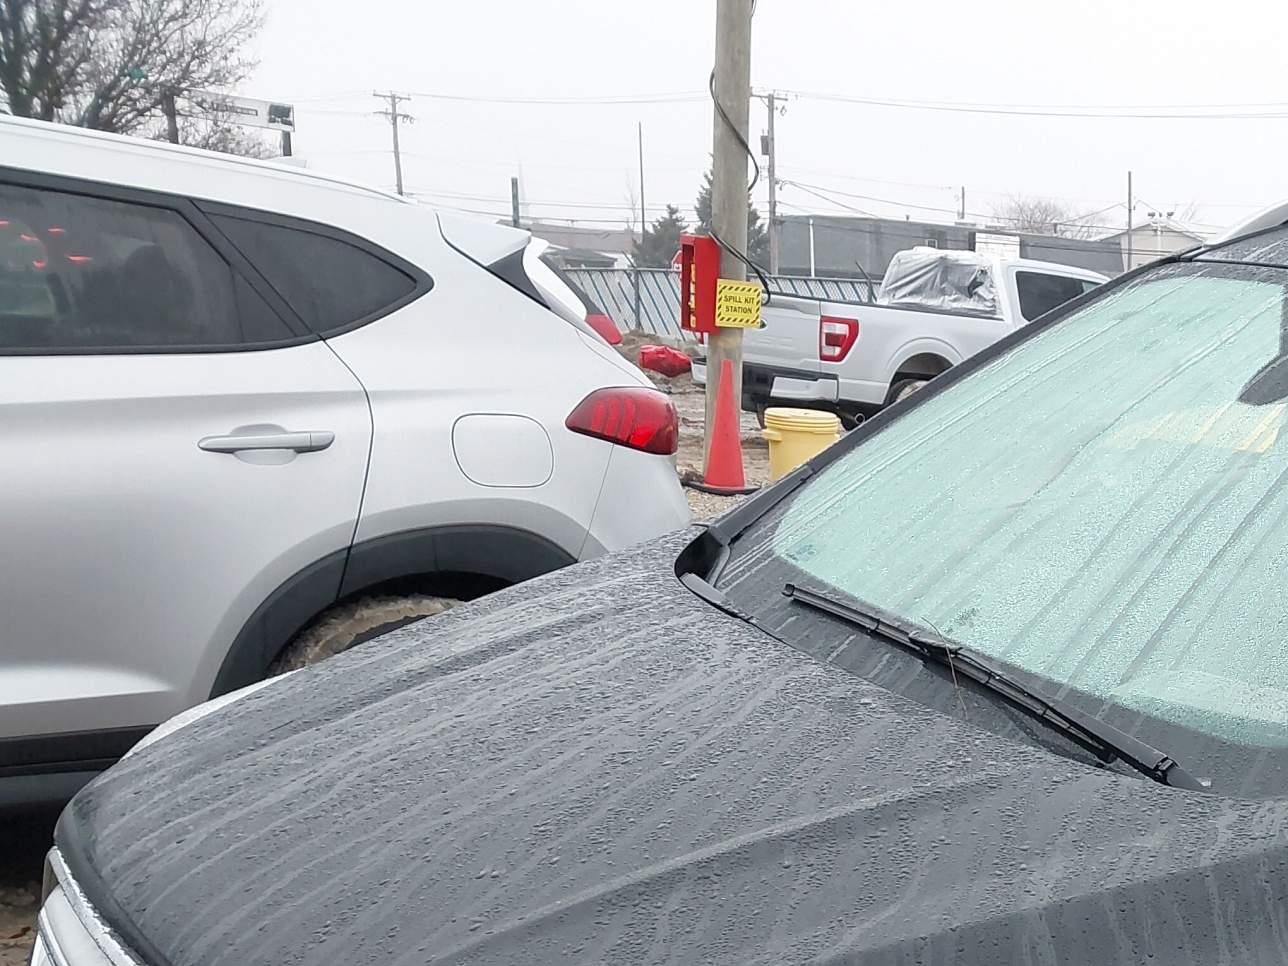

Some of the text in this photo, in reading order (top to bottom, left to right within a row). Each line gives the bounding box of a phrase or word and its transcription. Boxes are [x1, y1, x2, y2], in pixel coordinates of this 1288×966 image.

[723, 295, 755, 305] SPILL KIT
[725, 305, 753, 314] STATION
